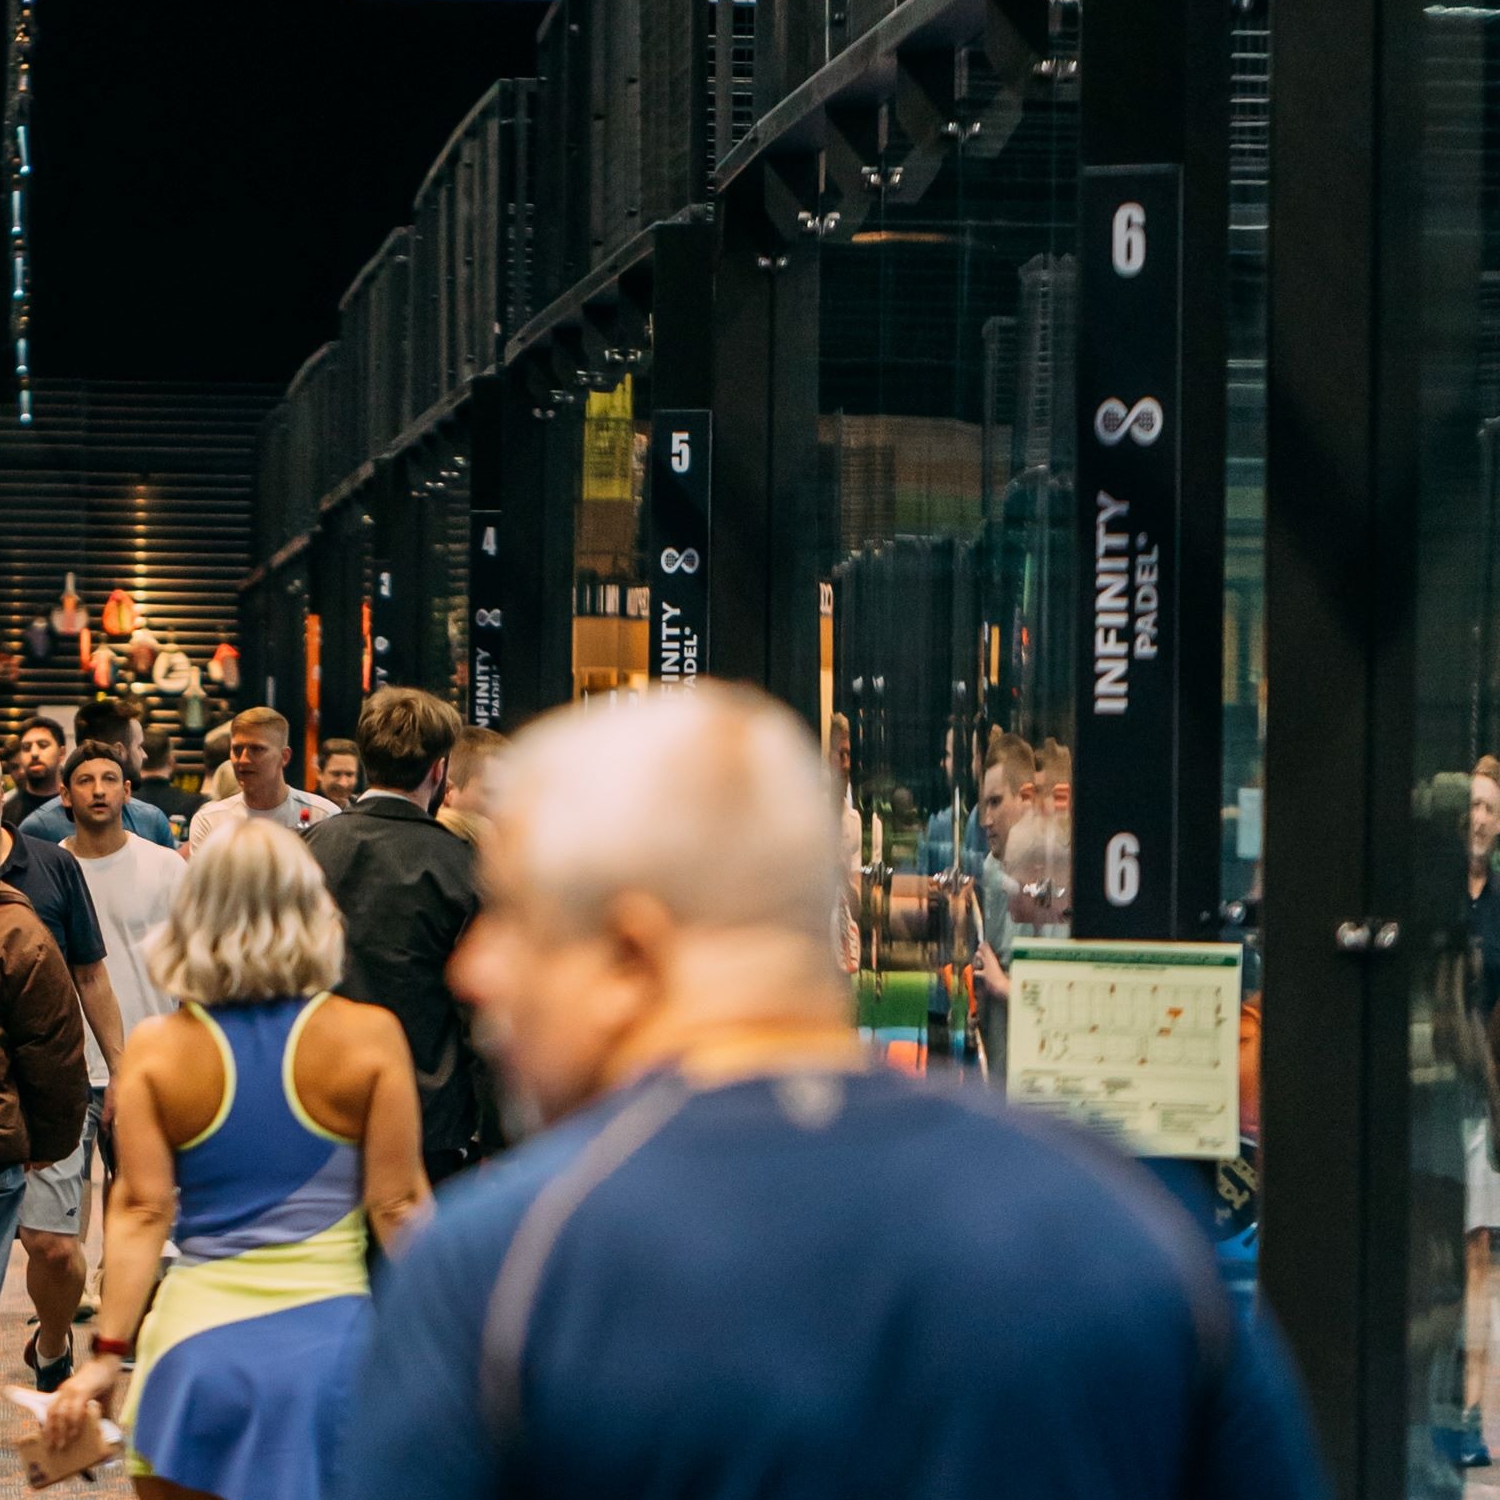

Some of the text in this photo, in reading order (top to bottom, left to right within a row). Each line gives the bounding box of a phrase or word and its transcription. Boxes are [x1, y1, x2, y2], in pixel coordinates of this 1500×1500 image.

[1112, 201, 1147, 278] 6
[671, 431, 691, 473] 5
[481, 526, 498, 557] 4
[1094, 490, 1130, 716] INFINITY
[475, 646, 492, 728] NFINITY
[1104, 832, 1140, 907] 6
